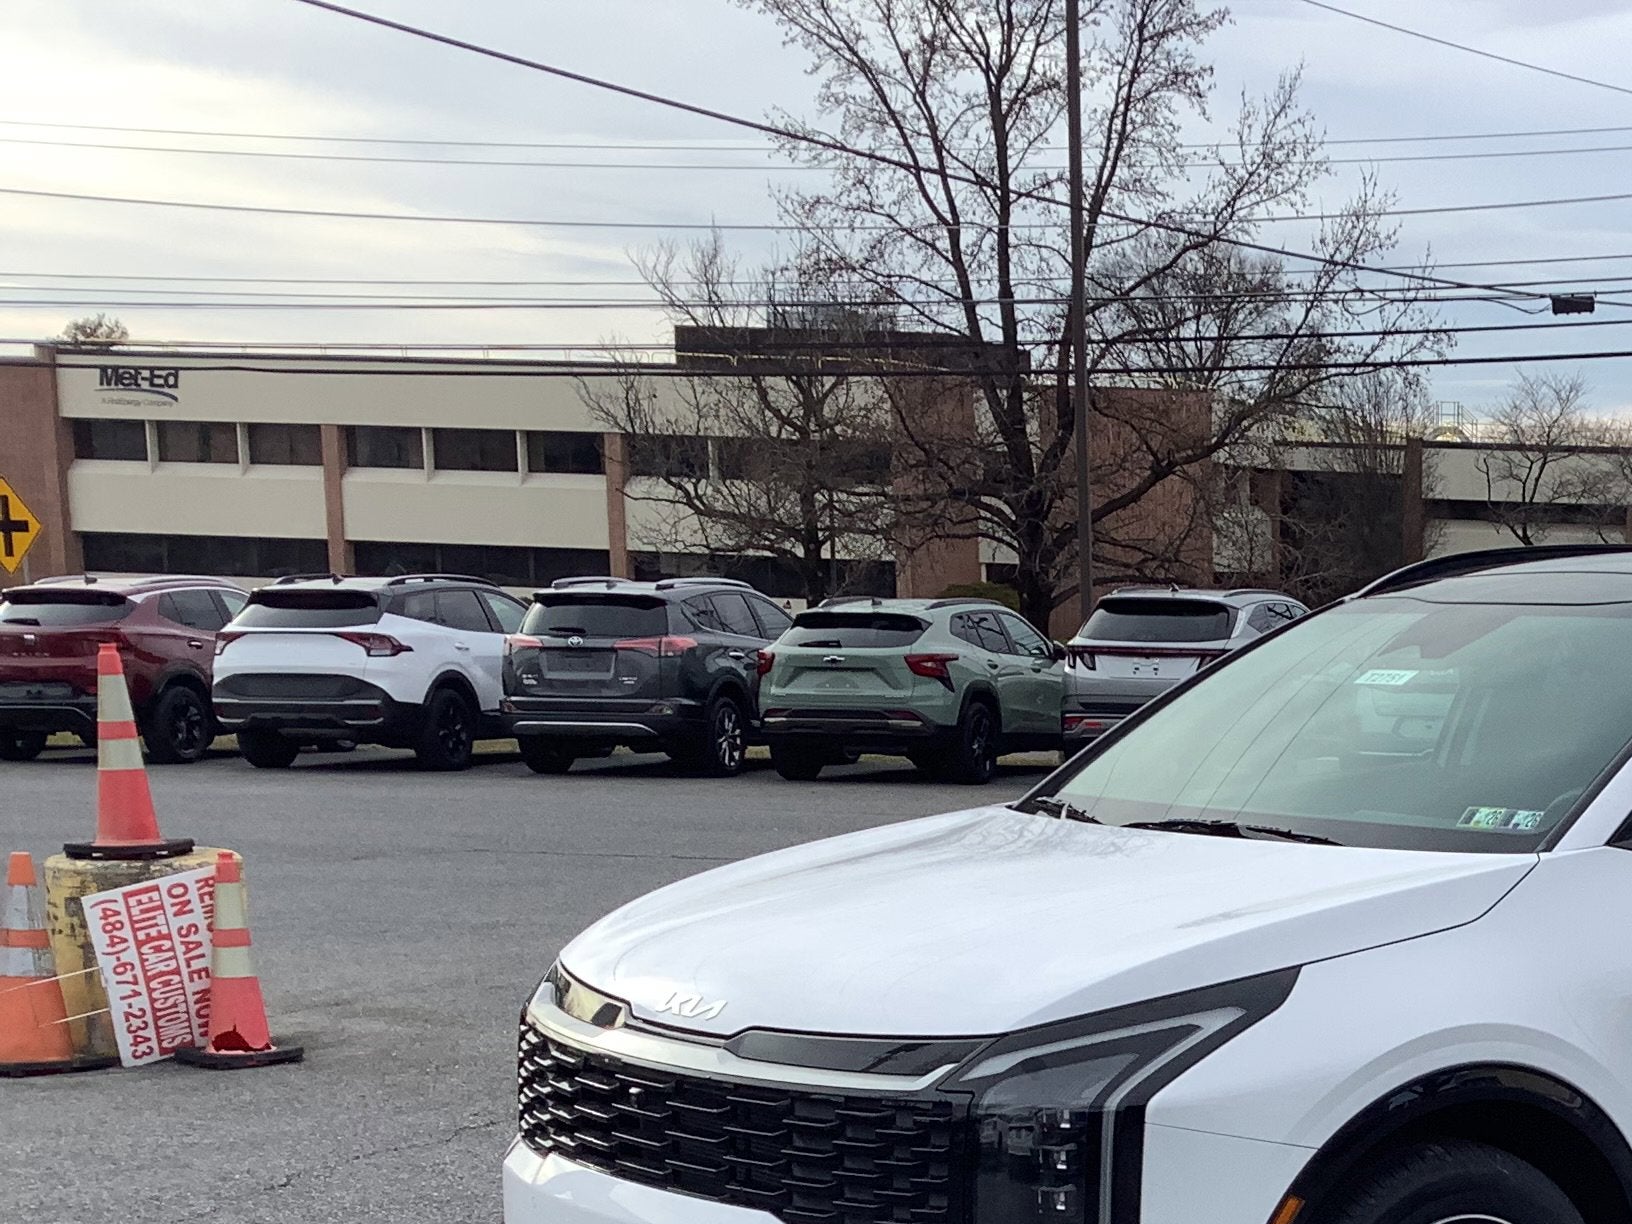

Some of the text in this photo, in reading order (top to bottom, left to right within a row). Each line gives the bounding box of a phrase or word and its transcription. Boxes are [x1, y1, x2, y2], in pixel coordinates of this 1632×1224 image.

[99, 366, 179, 388] Met-Ed
[166, 882, 194, 918] ON
[127, 889, 193, 1049] ELITE CAR CUSTOMS
[177, 923, 211, 983] SALE
[89, 898, 155, 1060] (484)-671-2343
[655, 991, 729, 1022] KIA
